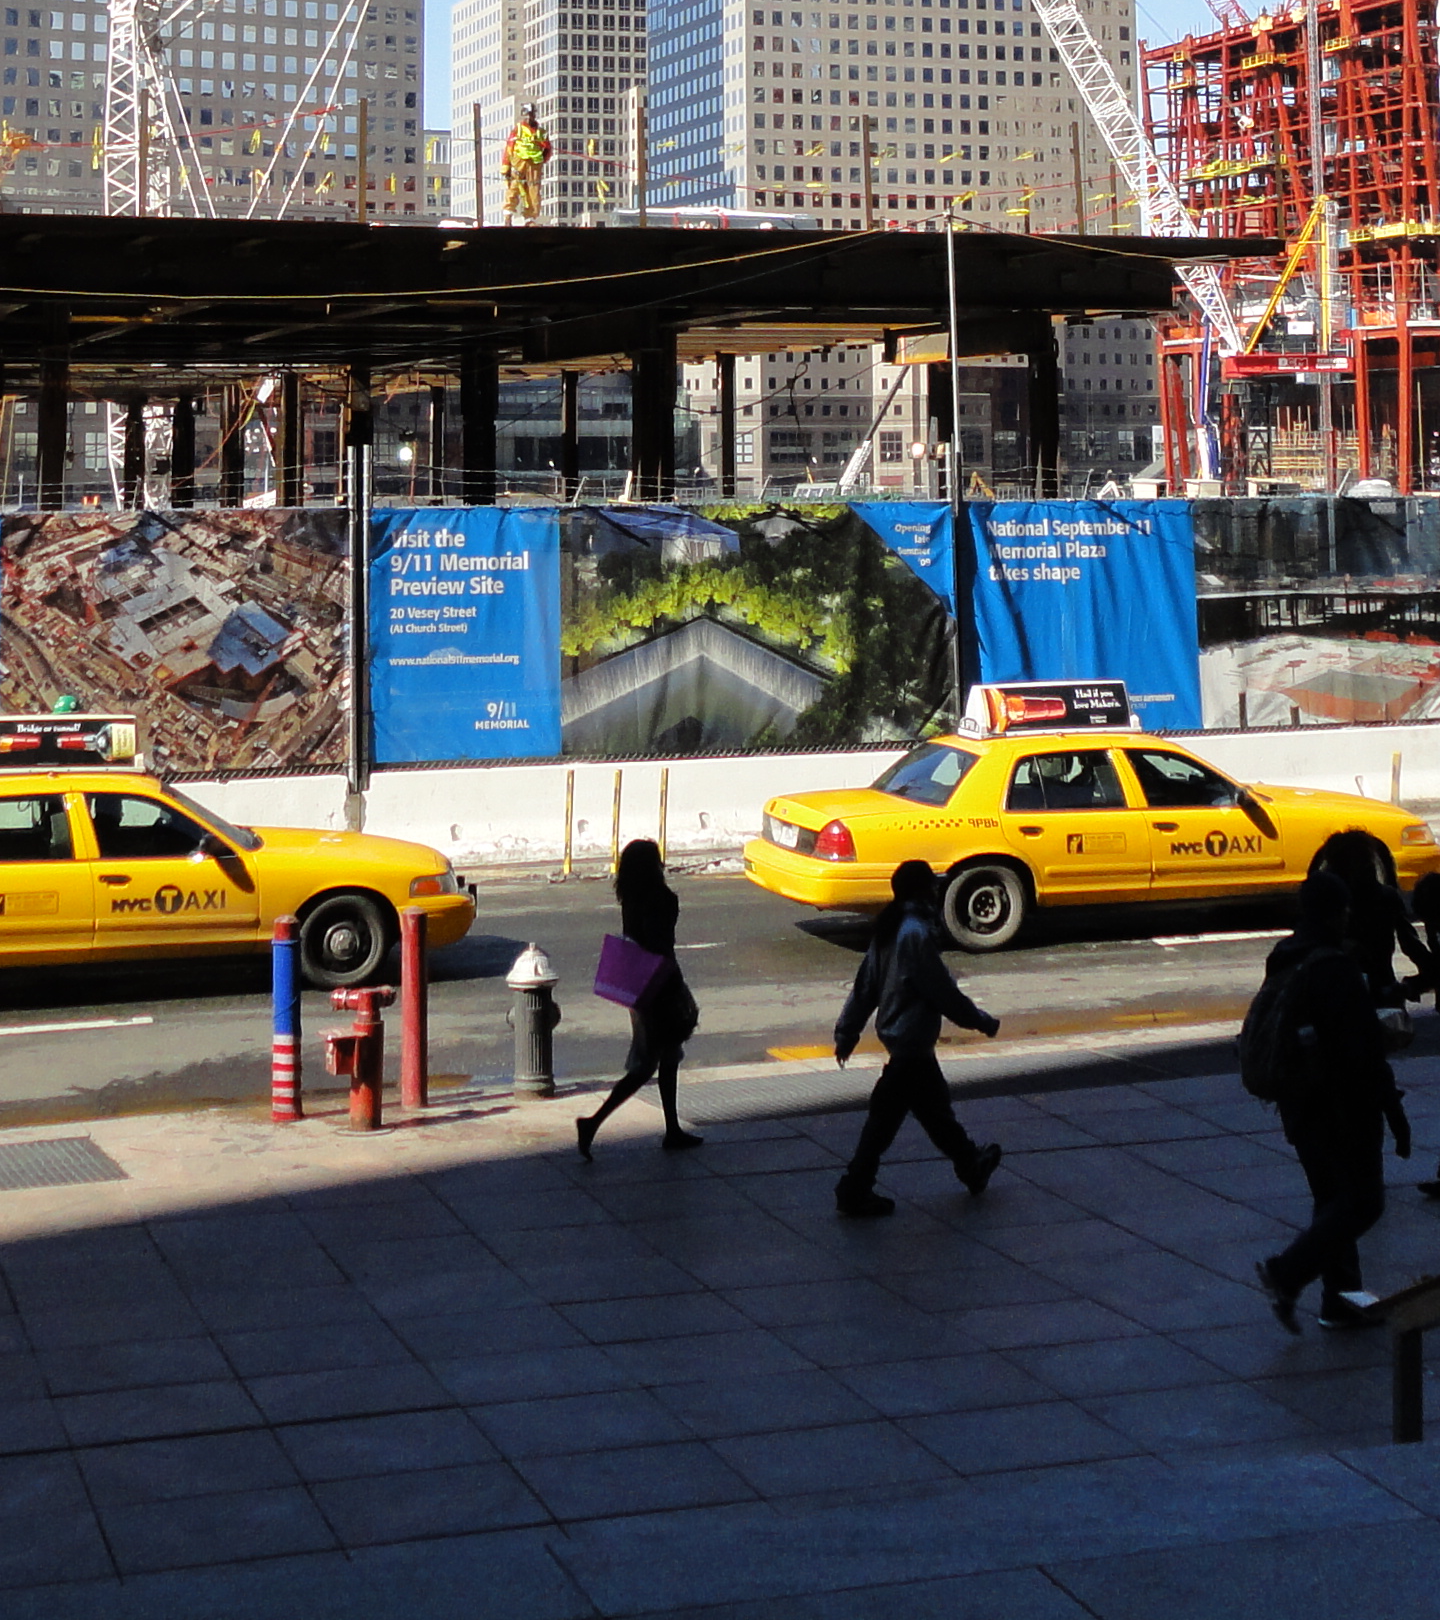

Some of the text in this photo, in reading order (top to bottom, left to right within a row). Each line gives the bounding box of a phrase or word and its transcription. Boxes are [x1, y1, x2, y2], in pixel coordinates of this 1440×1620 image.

[894, 523, 931, 534] Opening
[986, 518, 1151, 540] National September 11
[391, 529, 465, 549] Visit the
[989, 540, 1106, 560] Memorial Plaza
[390, 551, 529, 574] 9/11 Memorial
[988, 563, 1081, 585] takes shape
[390, 576, 504, 596] Preview Site
[389, 606, 477, 621] 20 Vesey Street
[389, 622, 468, 635] (At Church Street)
[486, 701, 517, 718] 9/11
[474, 719, 530, 730] MEMORIAL
[1170, 830, 1262, 857] NYC TAXI
[111, 884, 227, 915] NYC TAXI
